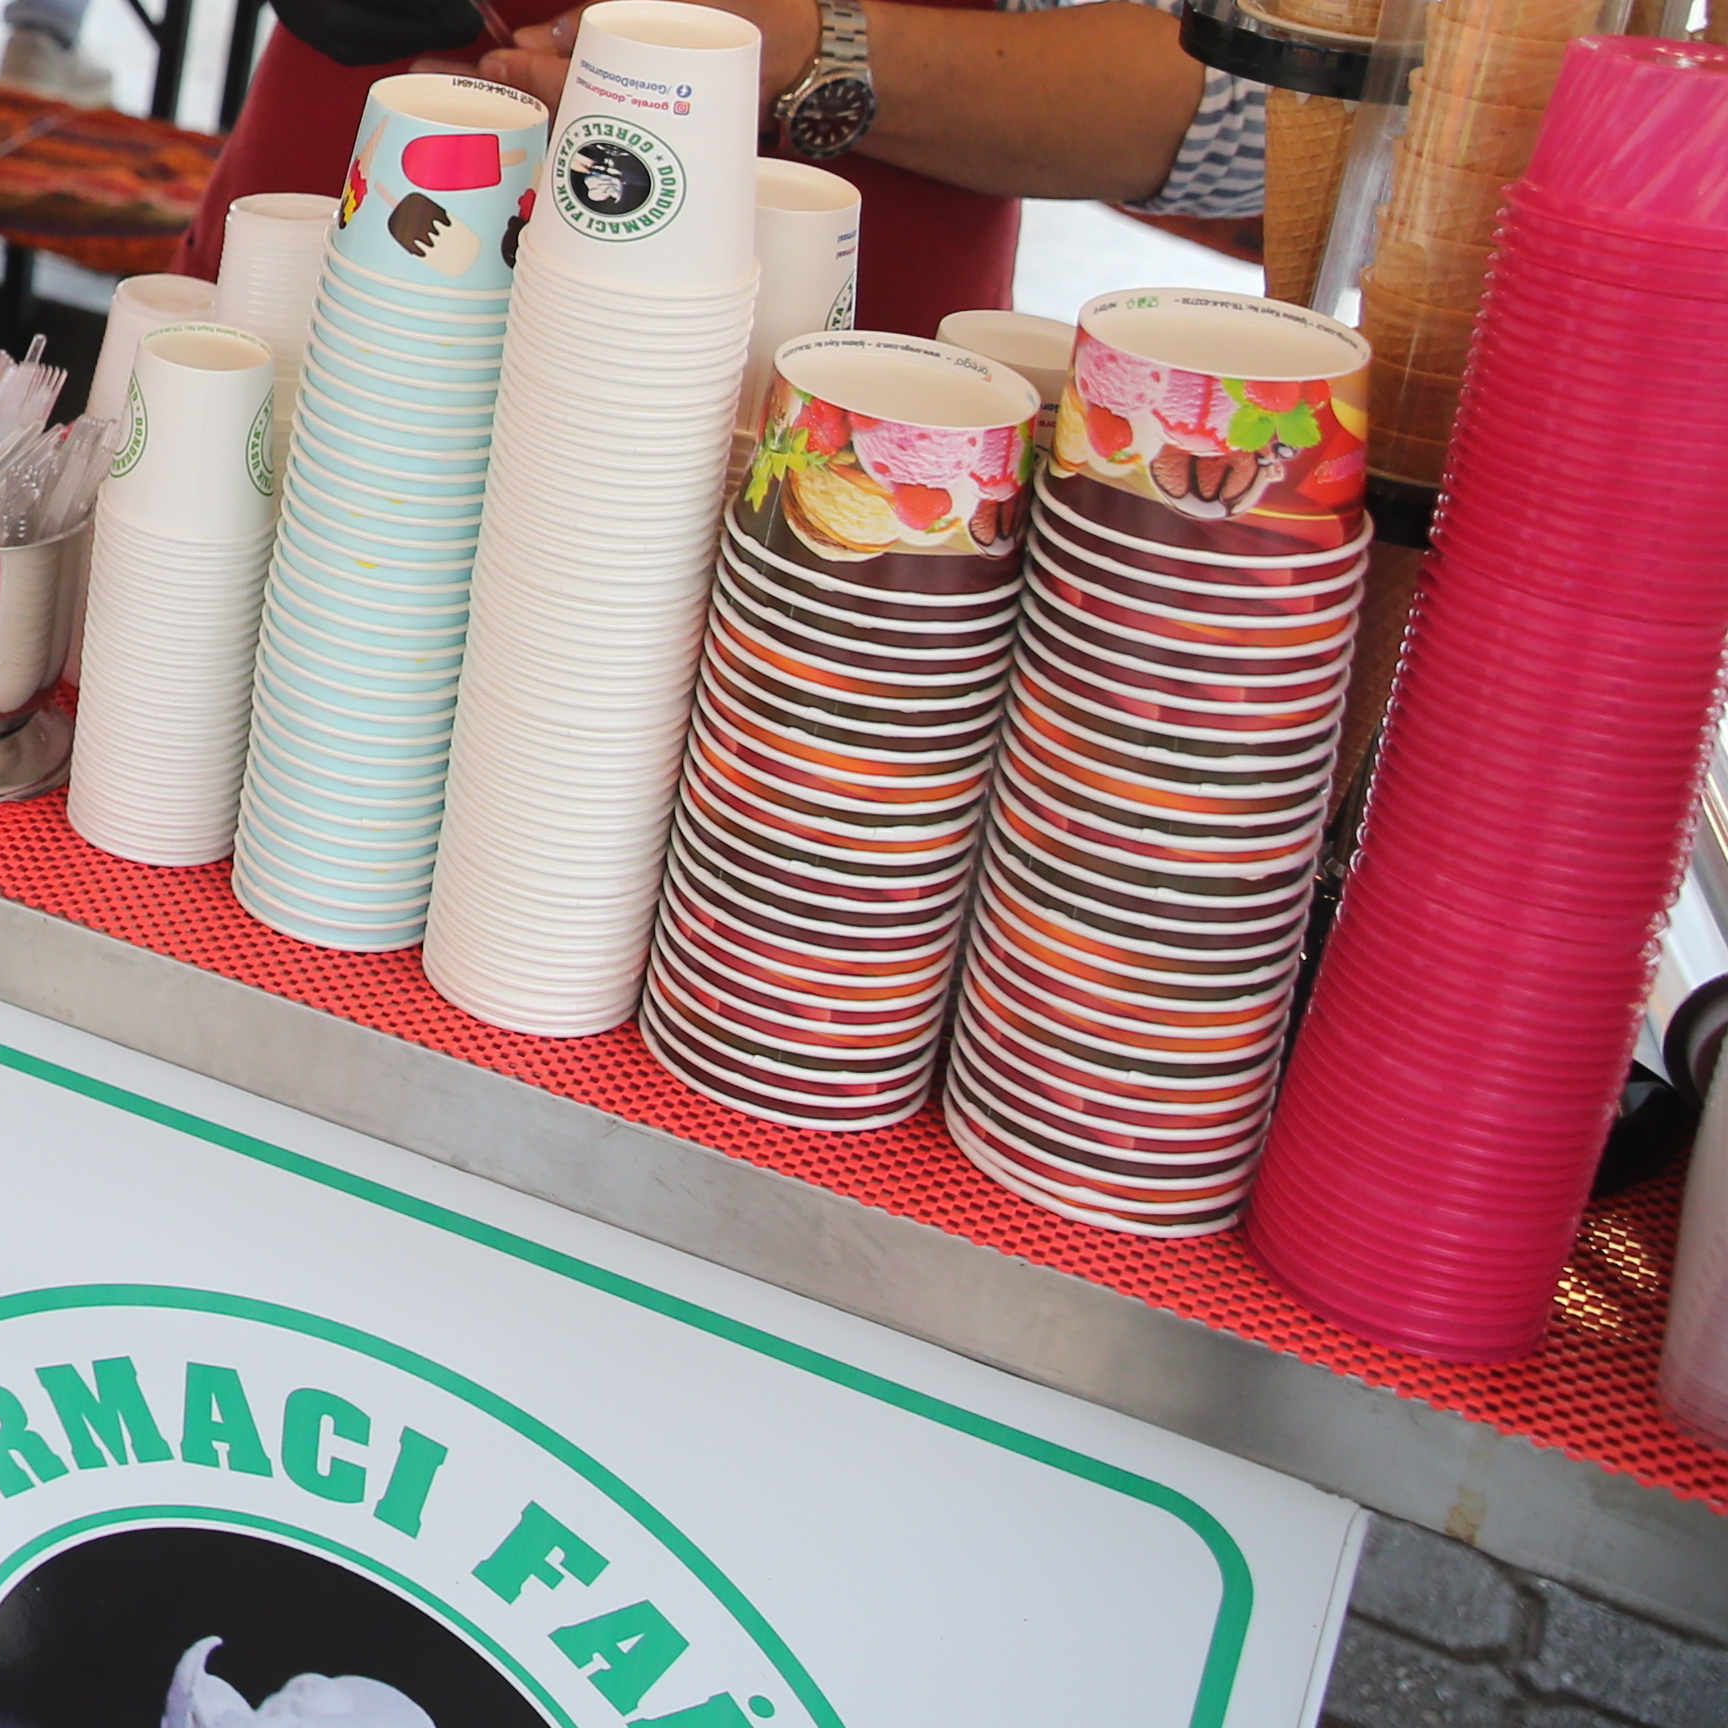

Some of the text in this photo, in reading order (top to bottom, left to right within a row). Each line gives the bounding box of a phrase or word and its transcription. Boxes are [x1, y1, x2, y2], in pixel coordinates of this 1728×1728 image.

[556, 137, 676, 234] DONDURMACI FAİK USTA
[582, 123, 654, 154] GÖRELE
[471, 1500, 776, 1728] FA
